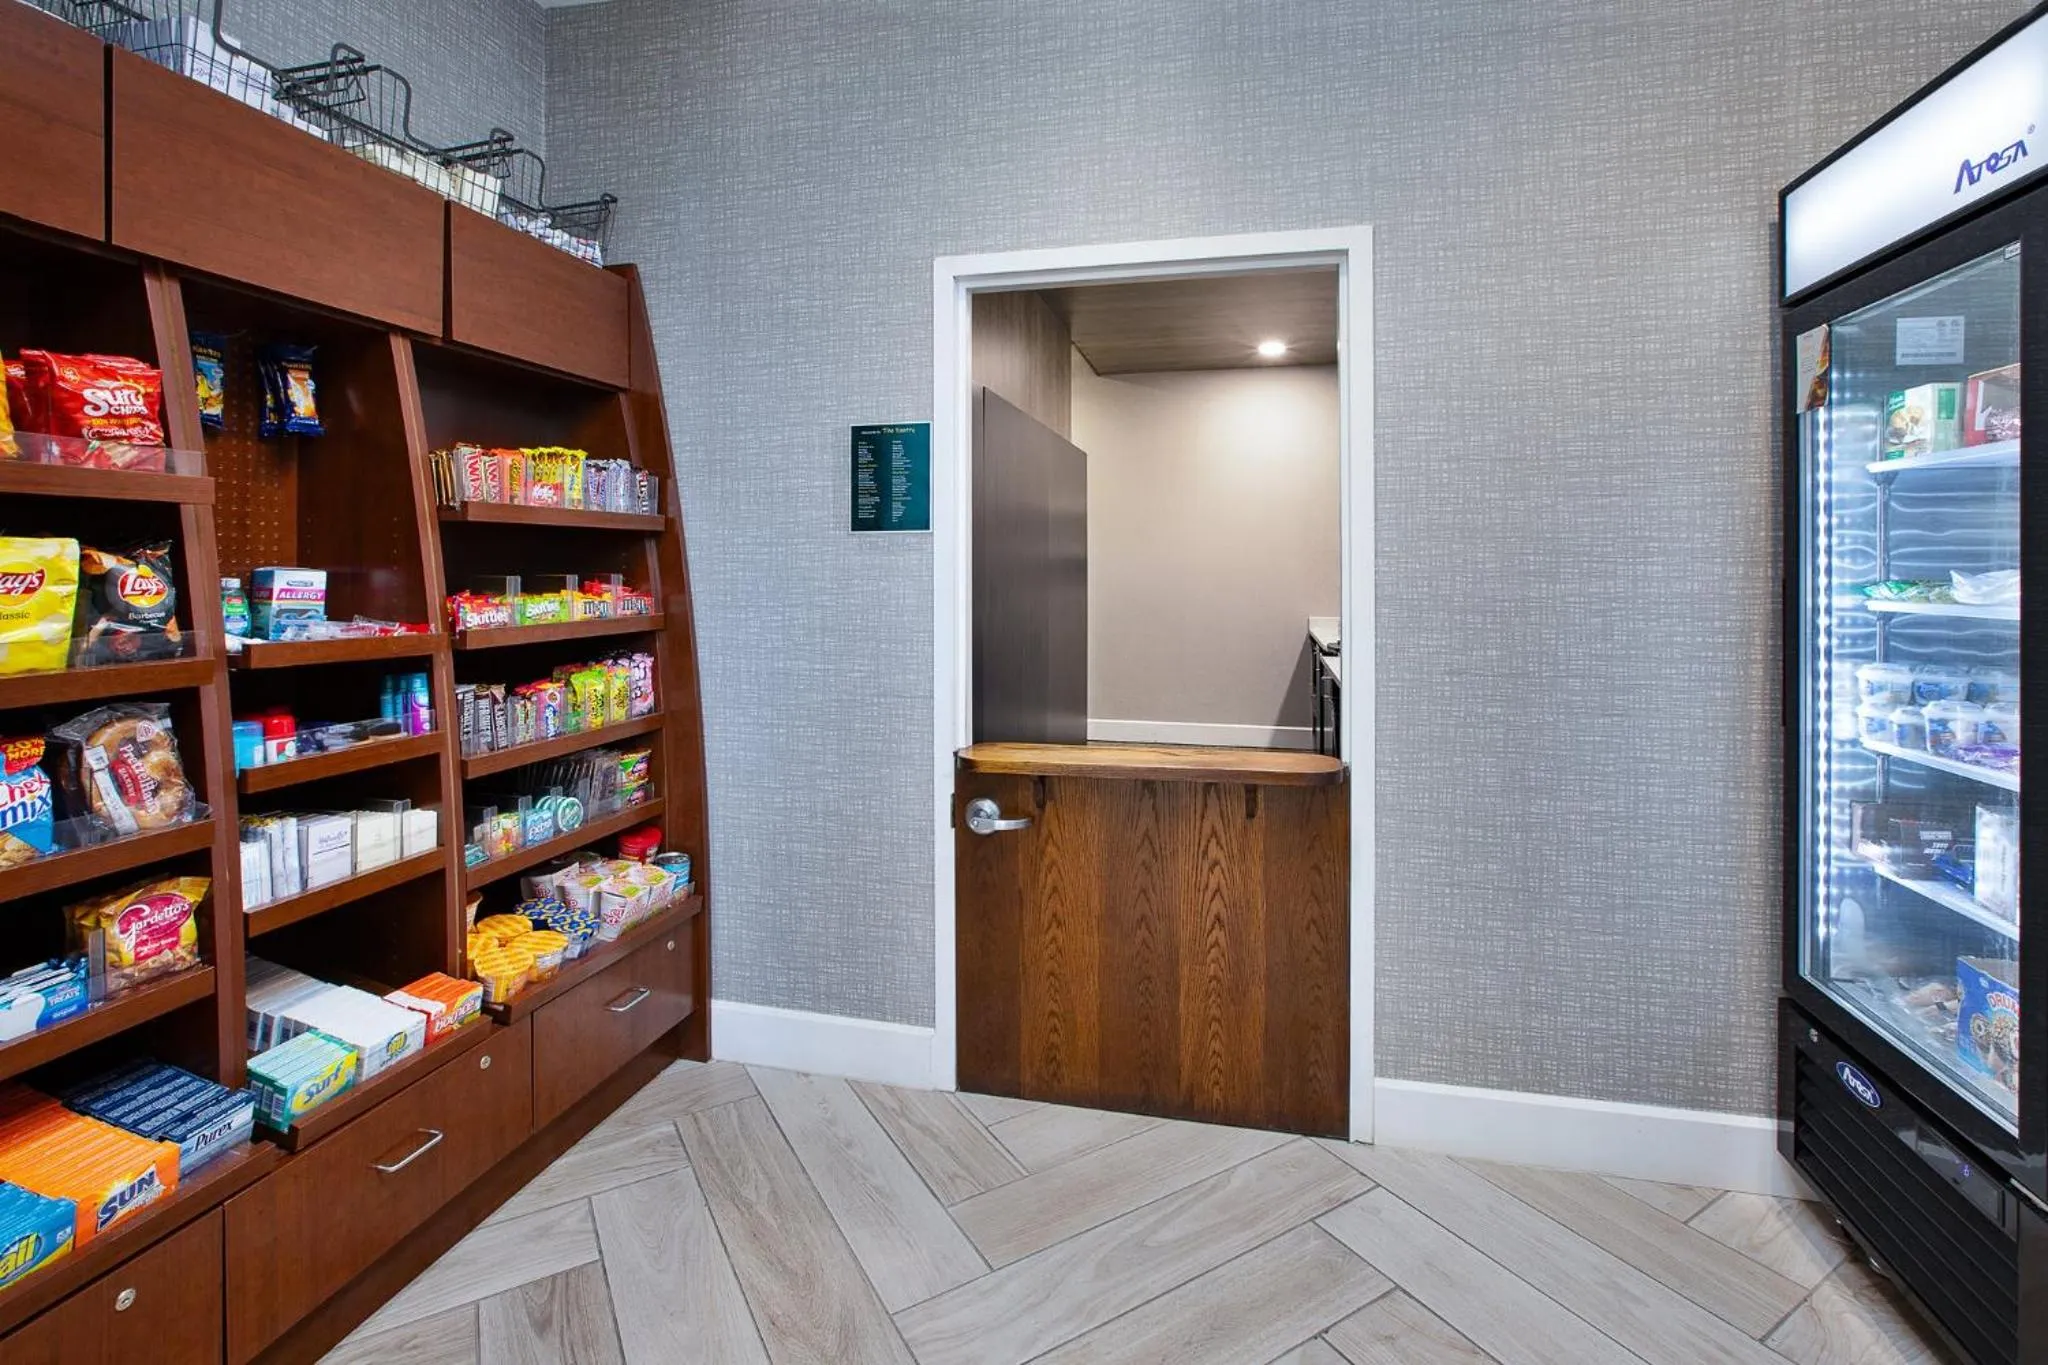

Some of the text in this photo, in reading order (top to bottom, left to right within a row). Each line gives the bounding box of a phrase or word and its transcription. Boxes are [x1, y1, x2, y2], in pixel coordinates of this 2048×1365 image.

[0, 573, 44, 596] ay's
[279, 588, 324, 600] ALLERGY
[0, 611, 31, 621] lassic
[193, 1119, 234, 1151] Purex
[99, 1169, 157, 1230] SUN
